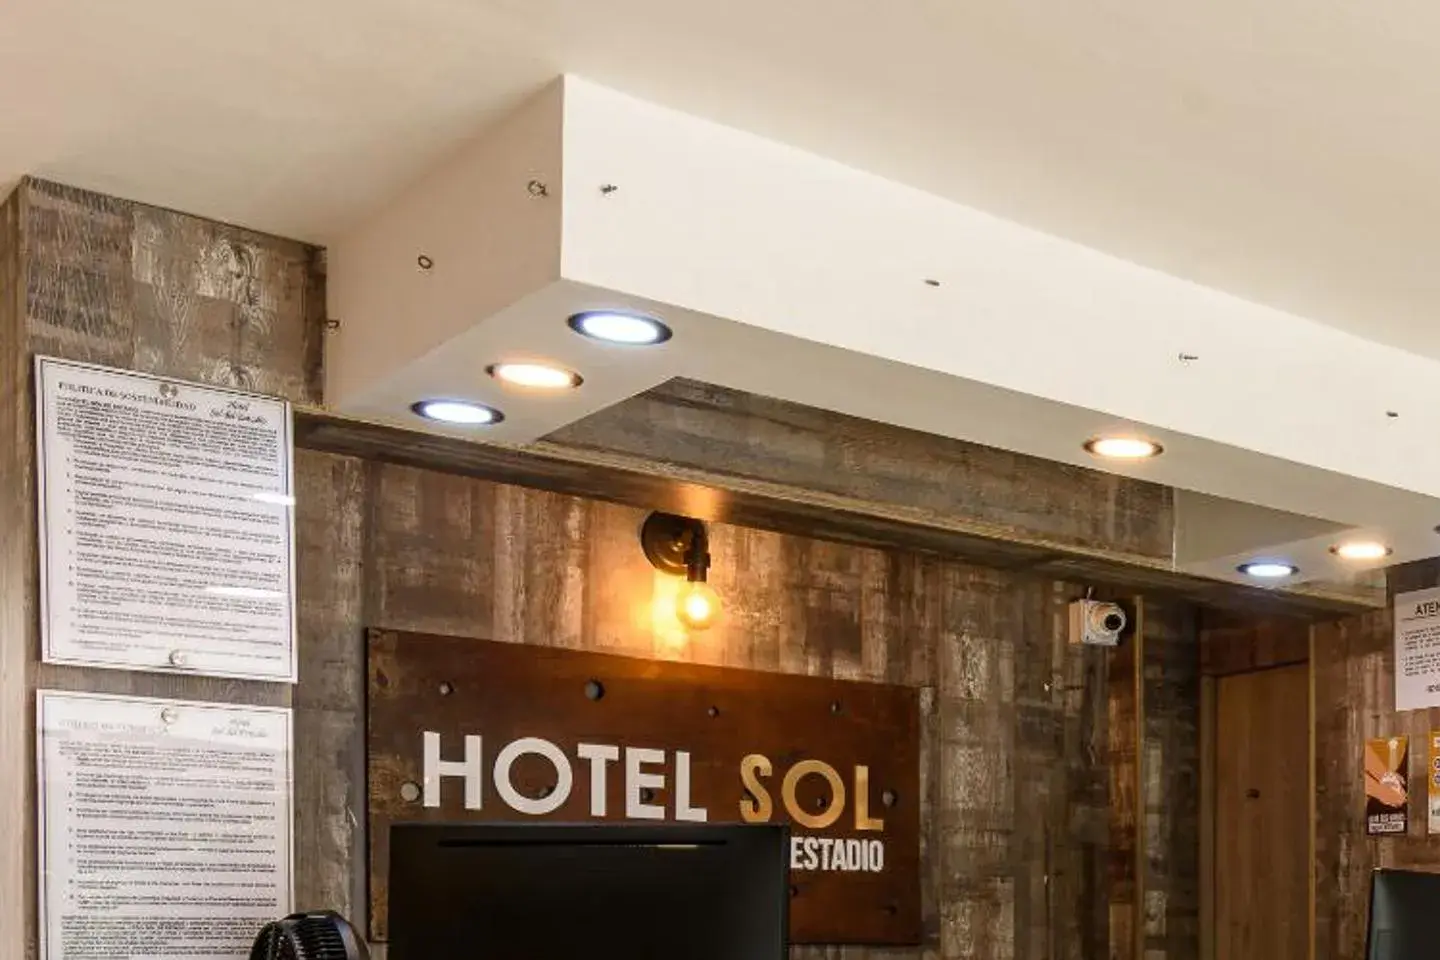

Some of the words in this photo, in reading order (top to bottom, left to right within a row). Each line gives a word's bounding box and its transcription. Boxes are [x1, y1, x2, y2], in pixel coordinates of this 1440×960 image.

[423, 731, 707, 822] HOTEL
[740, 753, 884, 831] SOL
[790, 836, 884, 872] ESTADIO
